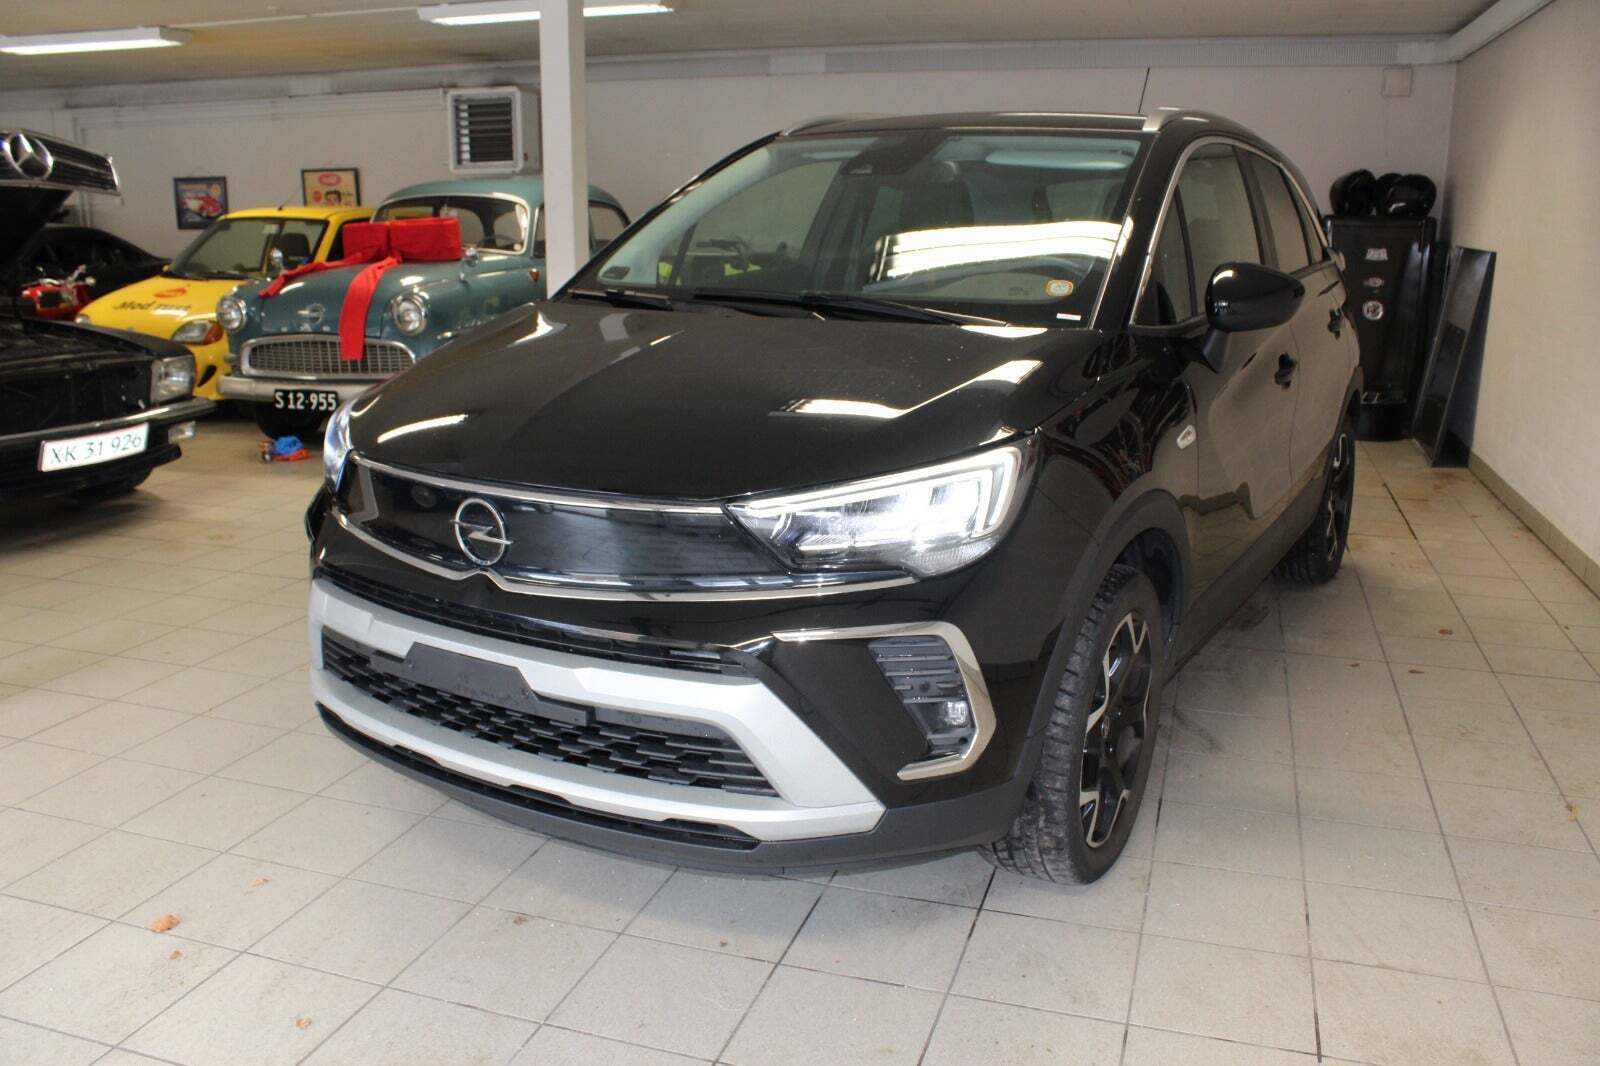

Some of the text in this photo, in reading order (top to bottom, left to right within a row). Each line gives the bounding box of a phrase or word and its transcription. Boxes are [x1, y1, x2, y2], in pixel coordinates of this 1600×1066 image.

[275, 391, 284, 409] S
[50, 444, 76, 464] XK
[84, 441, 103, 460] 31
